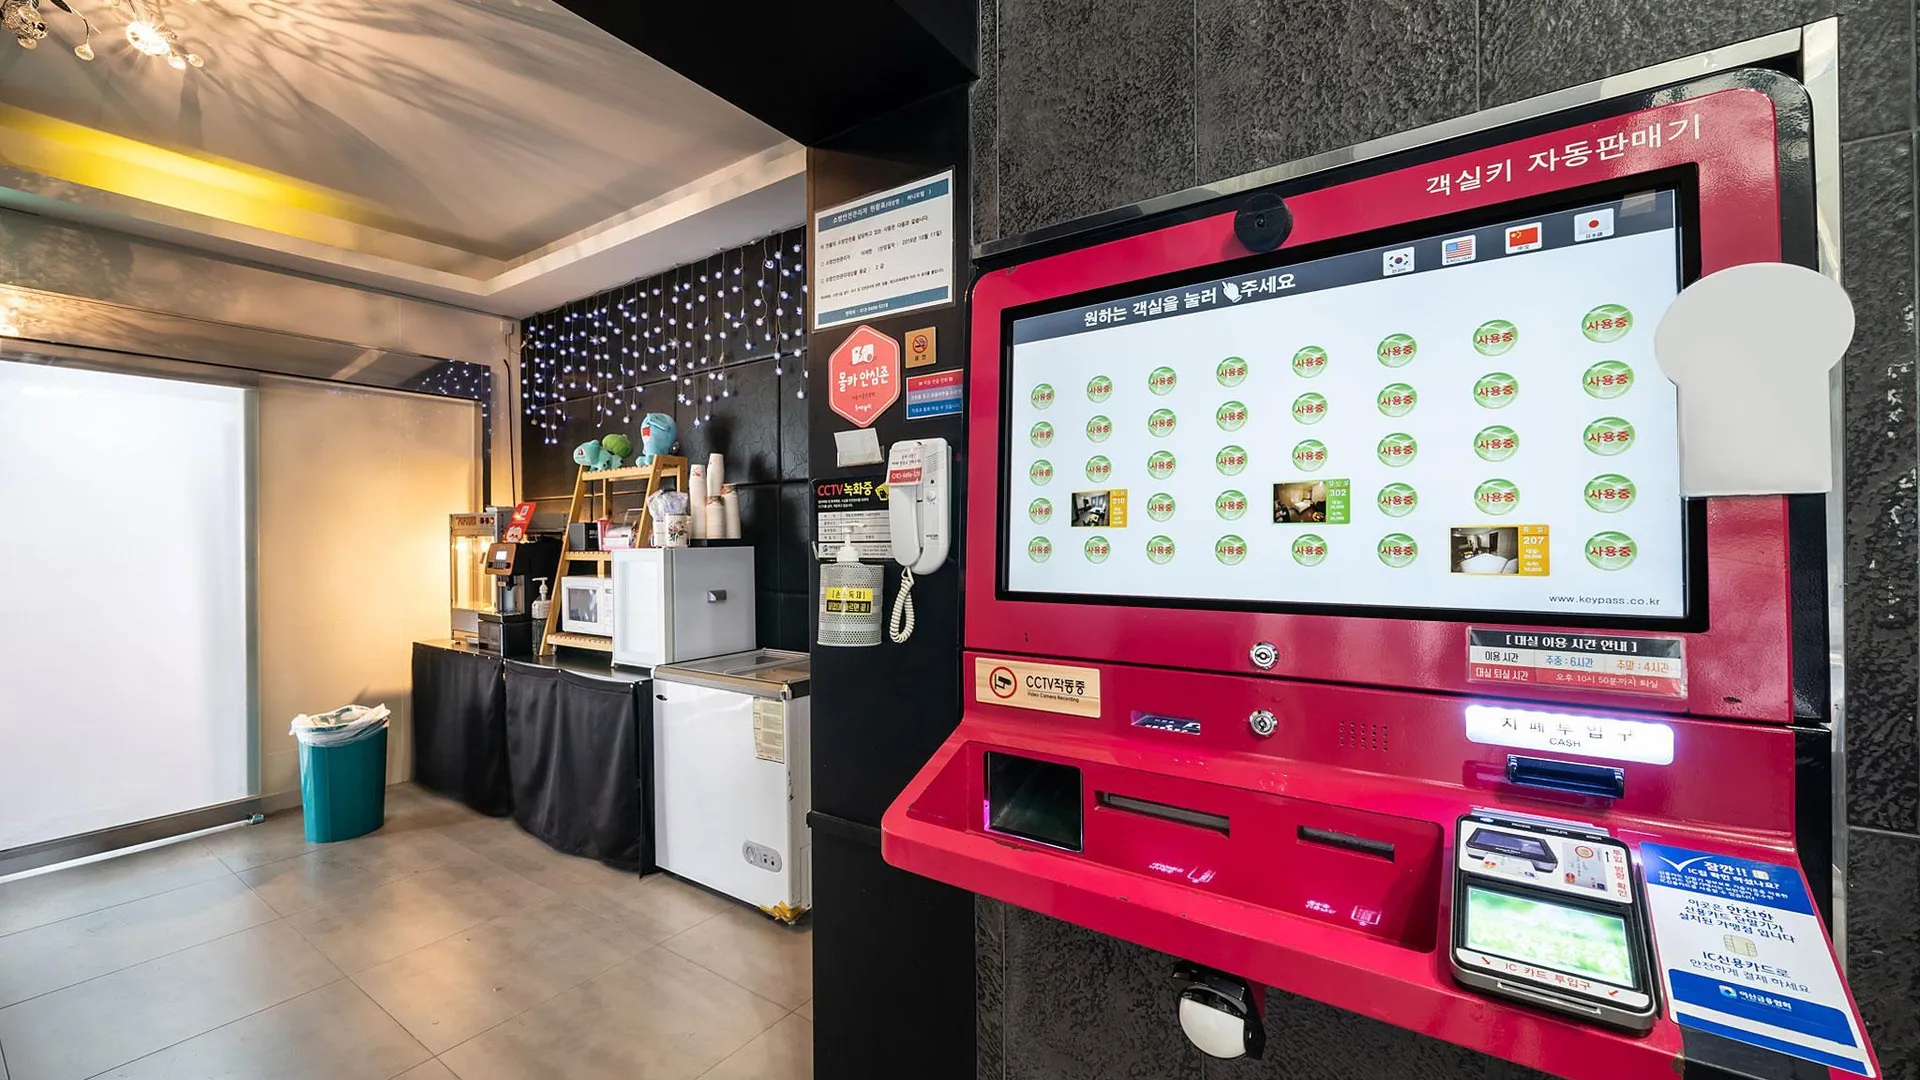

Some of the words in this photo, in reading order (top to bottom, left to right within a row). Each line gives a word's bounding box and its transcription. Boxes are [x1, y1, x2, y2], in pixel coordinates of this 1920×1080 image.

[1426, 159, 1511, 196] 객실키
[1527, 113, 1700, 171] 자동판매기
[1084, 306, 1127, 327] 원하는
[1132, 296, 1179, 317] 객실을
[1184, 288, 1216, 308] 눌러
[1240, 273, 1295, 297] 주세요
[1586, 317, 1628, 331] 사용중
[1477, 332, 1513, 344] 사용중
[1381, 345, 1413, 357] 사용중
[1296, 357, 1324, 367] 사용중
[1219, 367, 1245, 377] 사용중
[838, 372, 857, 392] 몰카
[860, 366, 890, 388] 안심존
[1151, 377, 1174, 386] 사용중
[1587, 374, 1629, 386] 사용중
[1089, 385, 1110, 394] 사용중
[1478, 384, 1514, 396] 사용중
[1033, 393, 1052, 401] 사용중
[1381, 395, 1413, 406] 사용중
[1296, 404, 1324, 414] 사용중
[1218, 411, 1245, 421] 사용중
[1150, 418, 1174, 427] 사용중
[1089, 425, 1110, 433] 사용중
[1588, 431, 1630, 443] 사용중
[1478, 438, 1515, 450] 사용중
[1296, 451, 1324, 461] 사용중
[1381, 445, 1413, 456] 사용중
[1150, 461, 1173, 470] 사용중
[1218, 456, 1245, 465] 사용중
[818, 484, 843, 496] CCTV
[844, 482, 873, 496] 녹화중
[1589, 488, 1631, 500] 사용중
[1381, 495, 1413, 506] 사용중
[1479, 492, 1515, 503] 사용중
[1150, 503, 1173, 511] 사용중
[1218, 501, 1244, 510] 사용중
[1087, 546, 1108, 554] 사용중
[1149, 546, 1172, 554] 사용중
[1218, 546, 1244, 555] 사용중
[1295, 546, 1324, 555] 사용중
[1381, 545, 1414, 556] 사용중
[1590, 546, 1632, 556] 사용중
[1549, 596, 1660, 605] www.keypass.co.kr
[1515, 636, 1538, 647] 대실
[1543, 637, 1568, 649] 이용
[1572, 639, 1596, 650] 시간
[1601, 640, 1627, 652] 안내
[1485, 651, 1500, 662] 이용
[1503, 652, 1518, 662] 시간
[1546, 655, 1562, 666] 주중
[1570, 658, 1593, 668] 6시간
[1616, 660, 1634, 670] 주말
[1643, 662, 1669, 673] 4시간
[1476, 668, 1491, 678] 대실
[1494, 669, 1509, 679] 퇴실
[1513, 671, 1528, 681] 시간
[1026, 676, 1085, 696] CCTV작동중
[1556, 673, 1573, 682] 오후
[1577, 674, 1595, 684] 10시
[1599, 675, 1636, 686] 50분까지
[1640, 678, 1658, 688] 퇴실
[1058, 694, 1079, 703] Recording
[1550, 738, 1580, 747] CASH
[1704, 861, 1748, 877] 잠깐!!
[1688, 899, 1723, 911] 이곳은
[1726, 904, 1773, 922] 안전한
[1684, 906, 1731, 920] 신용카드
[1734, 916, 1784, 932] 단말기가
[1718, 920, 1753, 934] 가맹점
[1758, 929, 1795, 943] 입니다
[1703, 952, 1790, 978] IC신용카드로
[1506, 962, 1517, 972] IC
[1524, 967, 1548, 979] 카드
[1555, 974, 1591, 990] 투입구
[1690, 959, 1739, 977] 안전하게
[1744, 971, 1768, 984] 결제
[1772, 979, 1810, 993] 하세요
